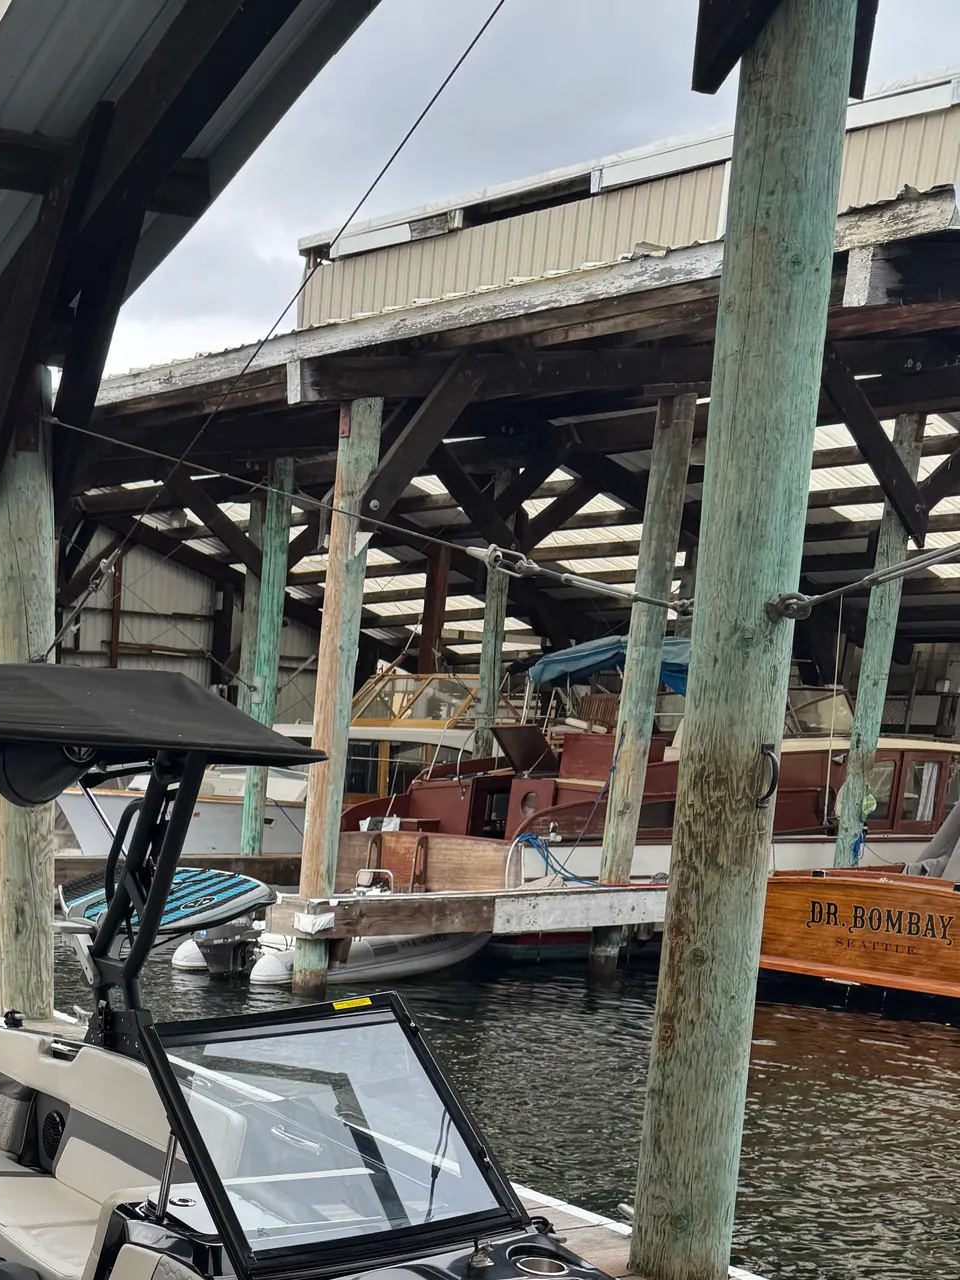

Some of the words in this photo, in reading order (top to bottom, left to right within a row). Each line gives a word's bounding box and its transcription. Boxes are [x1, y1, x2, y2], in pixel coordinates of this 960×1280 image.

[806, 899, 846, 929] DR.
[848, 904, 955, 946] BOMBAY
[835, 938, 917, 956] SEATTLE
